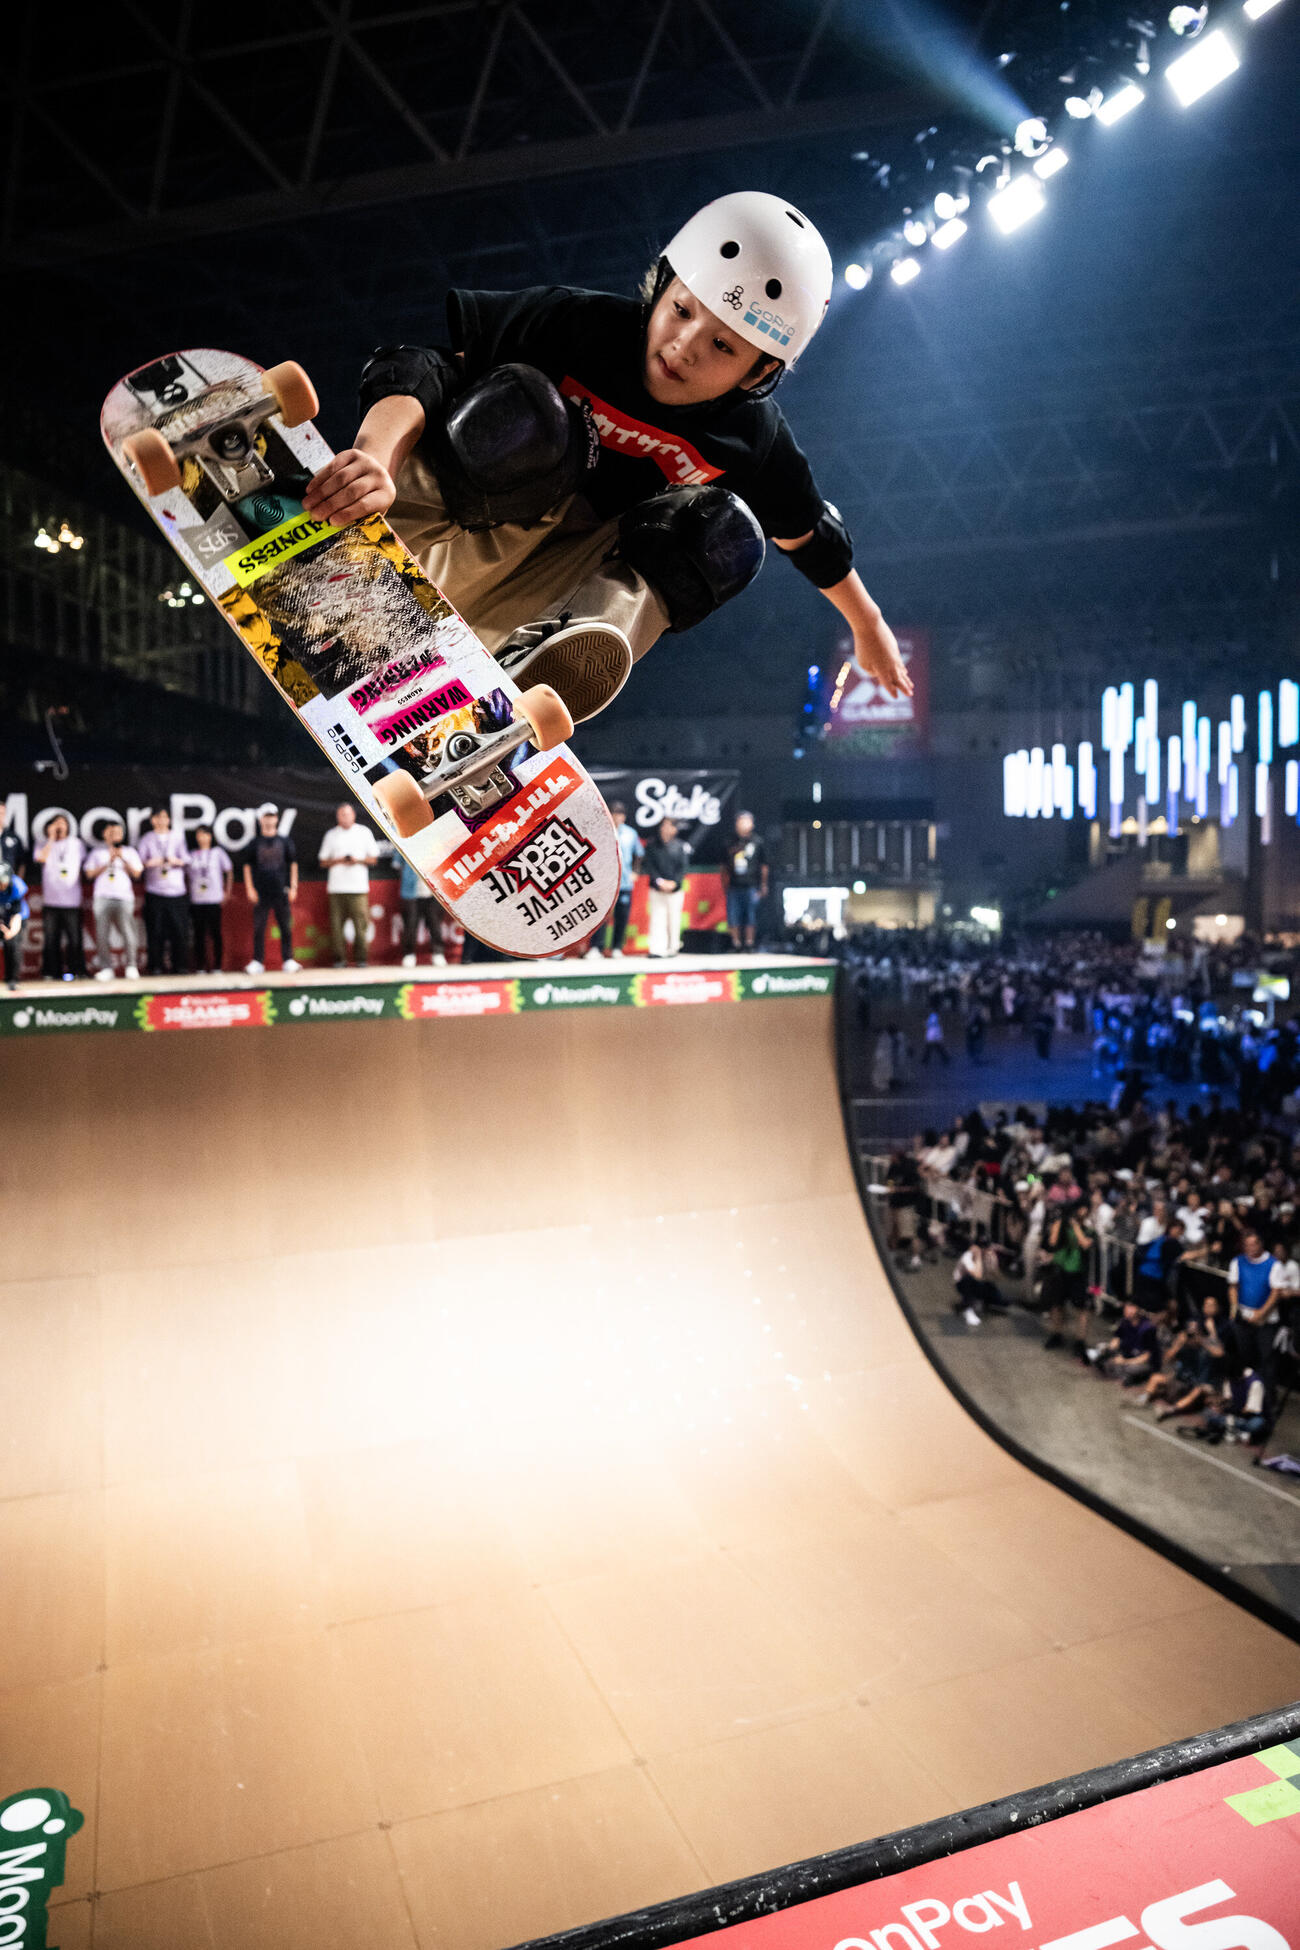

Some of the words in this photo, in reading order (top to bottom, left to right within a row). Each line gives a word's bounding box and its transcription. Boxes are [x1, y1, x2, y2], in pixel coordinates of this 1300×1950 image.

[750, 301, 795, 336] GoPro
[570, 395, 709, 485] カイサイクル
[238, 519, 332, 574] ADNESS
[351, 649, 439, 707] WARNING
[398, 687, 423, 705] MADNESS
[381, 686, 468, 746] WARNING
[327, 728, 360, 773] GoPro
[508, 821, 565, 881] DECK
[529, 833, 590, 890] TECH
[546, 897, 598, 941] BELIEVE
[36, 1007, 118, 1028] MoonPay
[309, 996, 384, 1015] MoonPay
[551, 984, 620, 1004] MoonPay
[0, 1842, 47, 1950] Moo
